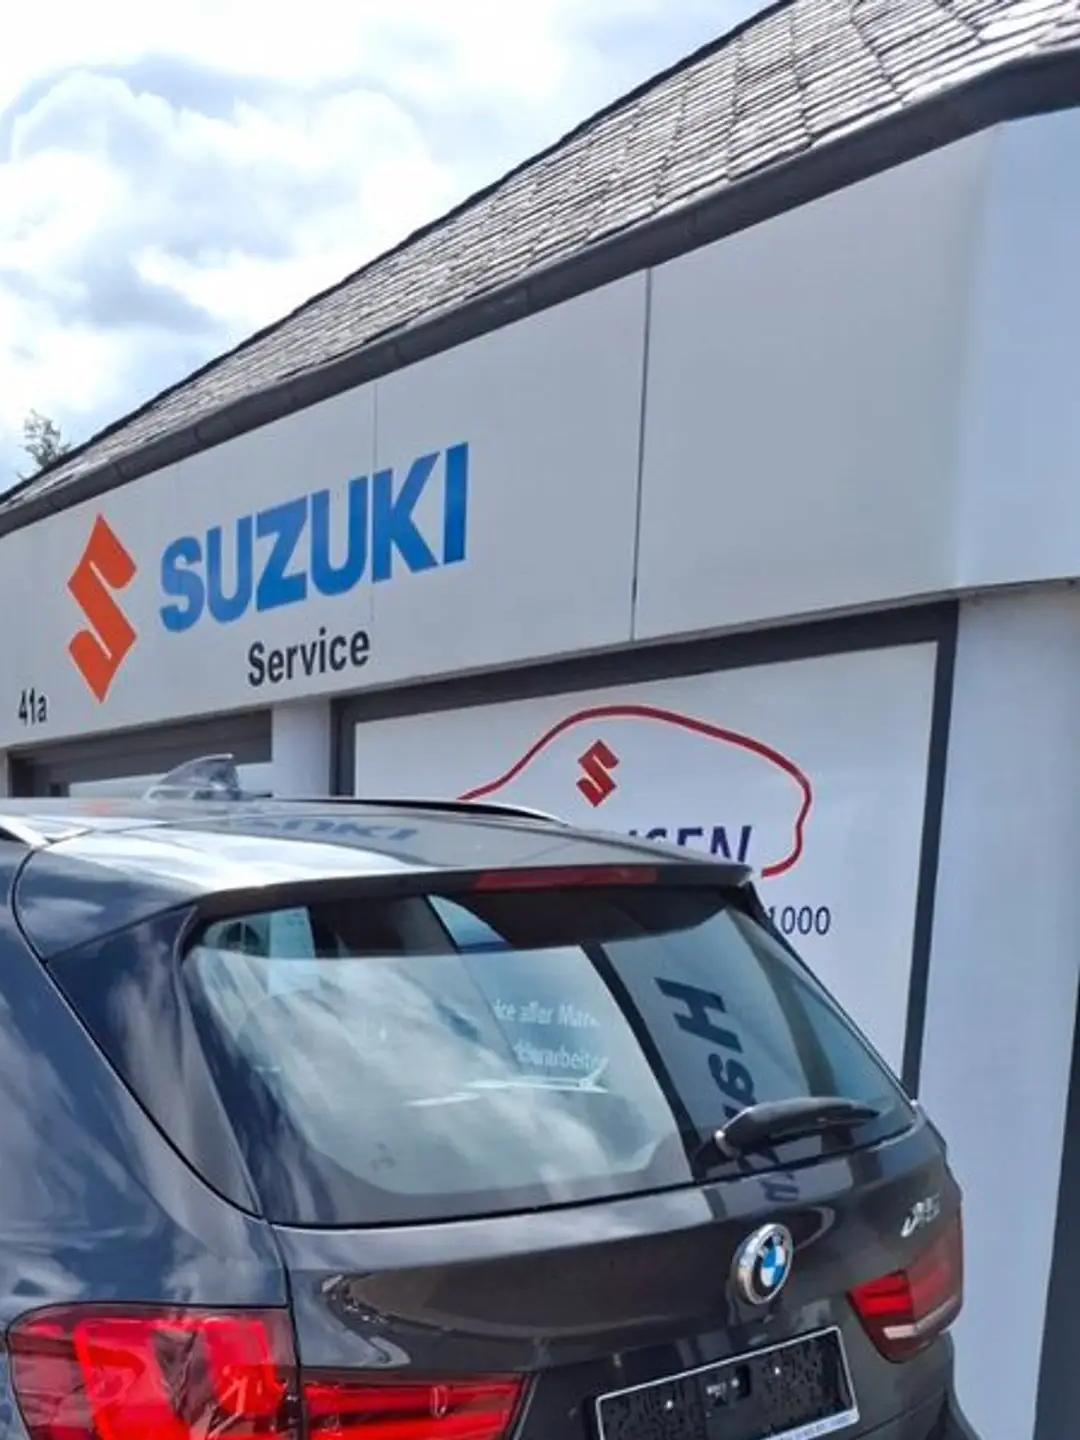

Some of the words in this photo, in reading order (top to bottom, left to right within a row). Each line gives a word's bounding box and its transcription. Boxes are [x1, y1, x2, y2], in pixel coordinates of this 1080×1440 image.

[159, 442, 469, 632] SUZUKI
[248, 626, 369, 687] Service
[19, 688, 47, 726] 41a
